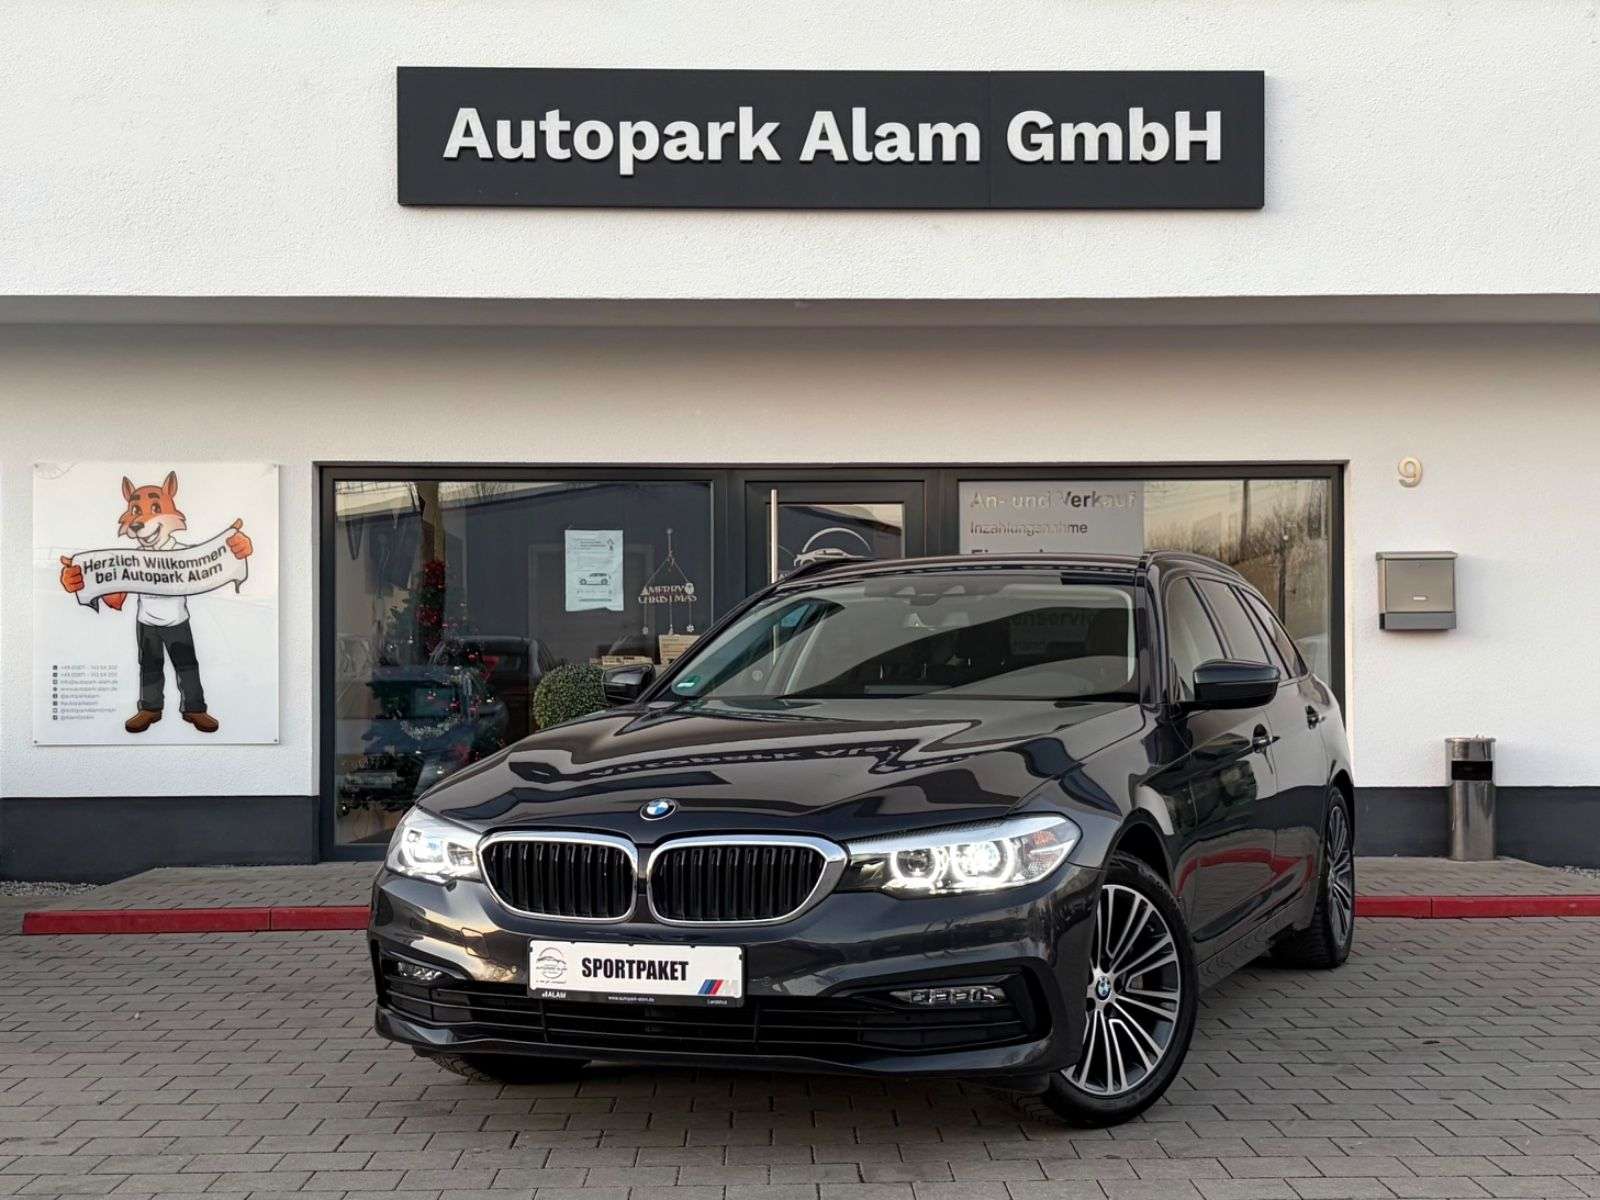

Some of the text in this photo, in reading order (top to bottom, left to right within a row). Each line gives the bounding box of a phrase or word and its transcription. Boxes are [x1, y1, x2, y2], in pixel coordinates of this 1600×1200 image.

[442, 106, 1222, 177] Autopark Alam GmbH
[1397, 457, 1423, 488] 9
[83, 545, 227, 575] Herzlich Willkommen
[95, 562, 223, 584] bei Autopark Alam
[581, 957, 689, 981] SPORTPAKET
